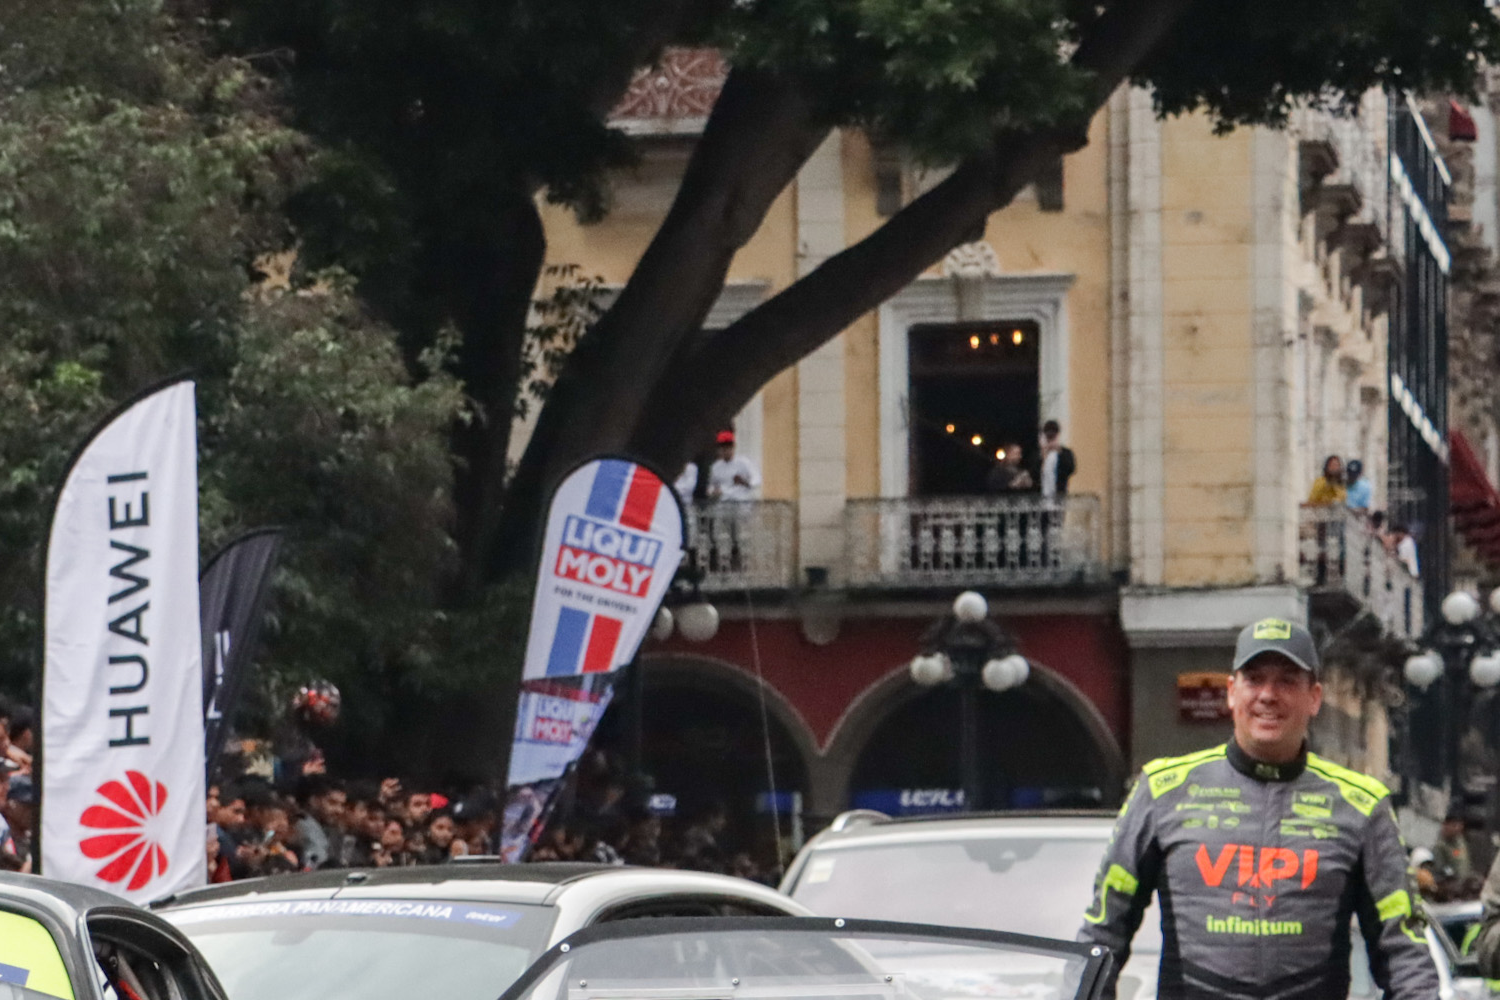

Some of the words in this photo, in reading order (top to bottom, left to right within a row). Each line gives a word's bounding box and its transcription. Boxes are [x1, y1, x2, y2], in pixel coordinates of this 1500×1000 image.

[564, 517, 660, 568] LIQUI
[558, 548, 651, 594] MOLY
[106, 470, 151, 748] HUAWEI
[1194, 843, 1319, 890] VIPI
[292, 901, 453, 920] PANAMERICANA
[1205, 915, 1303, 936] infinitum
